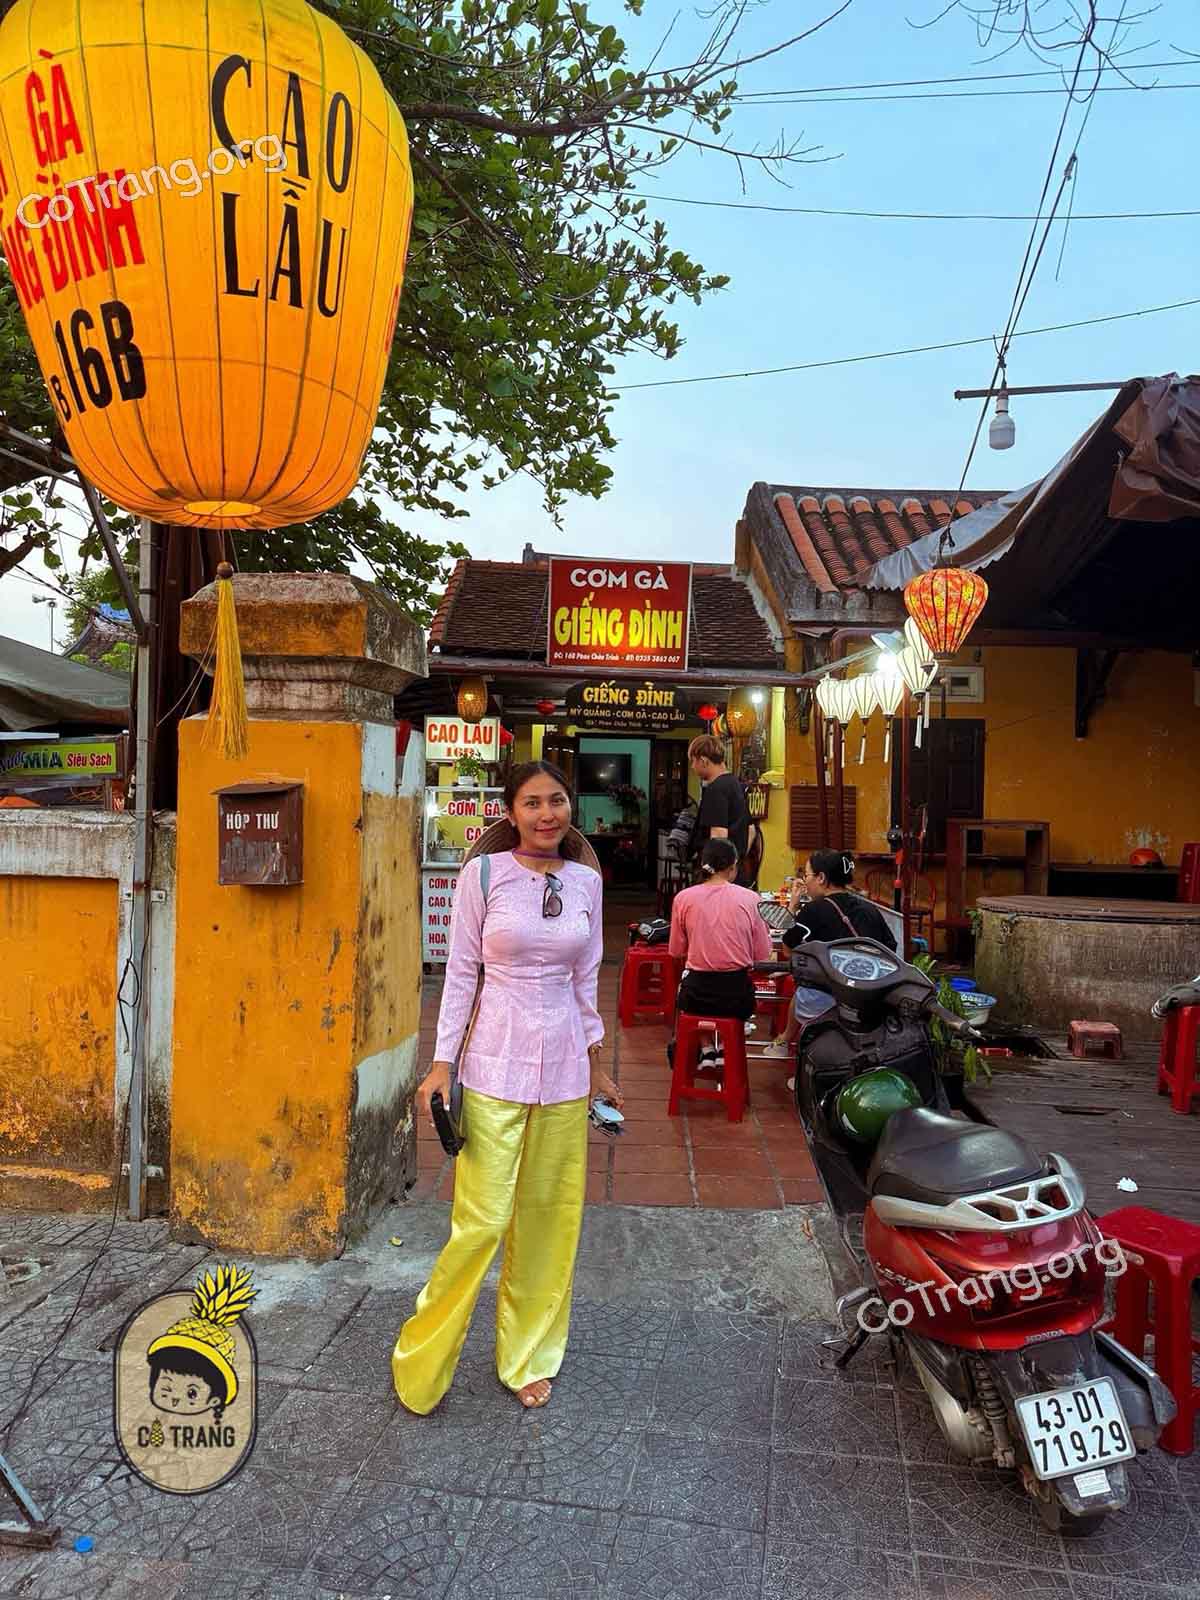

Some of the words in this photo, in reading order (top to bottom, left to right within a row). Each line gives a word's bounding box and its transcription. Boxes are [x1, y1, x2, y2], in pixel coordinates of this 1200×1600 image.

[25, 48, 84, 168] GÀ
[211, 54, 354, 194] CAO
[55, 300, 147, 414] 16B
[570, 568, 628, 588] CƠM
[634, 566, 669, 590] GÀ
[554, 592, 625, 648] GIẾNG
[628, 600, 683, 649] ĐÌNH
[583, 680, 630, 705] GIẾNG
[428, 724, 458, 743] CAO
[67, 752, 87, 767] Siêu
[89, 753, 112, 769] Sạch
[226, 810, 250, 834] HỘP
[255, 811, 280, 830] THƯ
[448, 800, 476, 816] CƠM
[1035, 1387, 1106, 1433] 43-D1
[1034, 1420, 1128, 1472] 719.29
